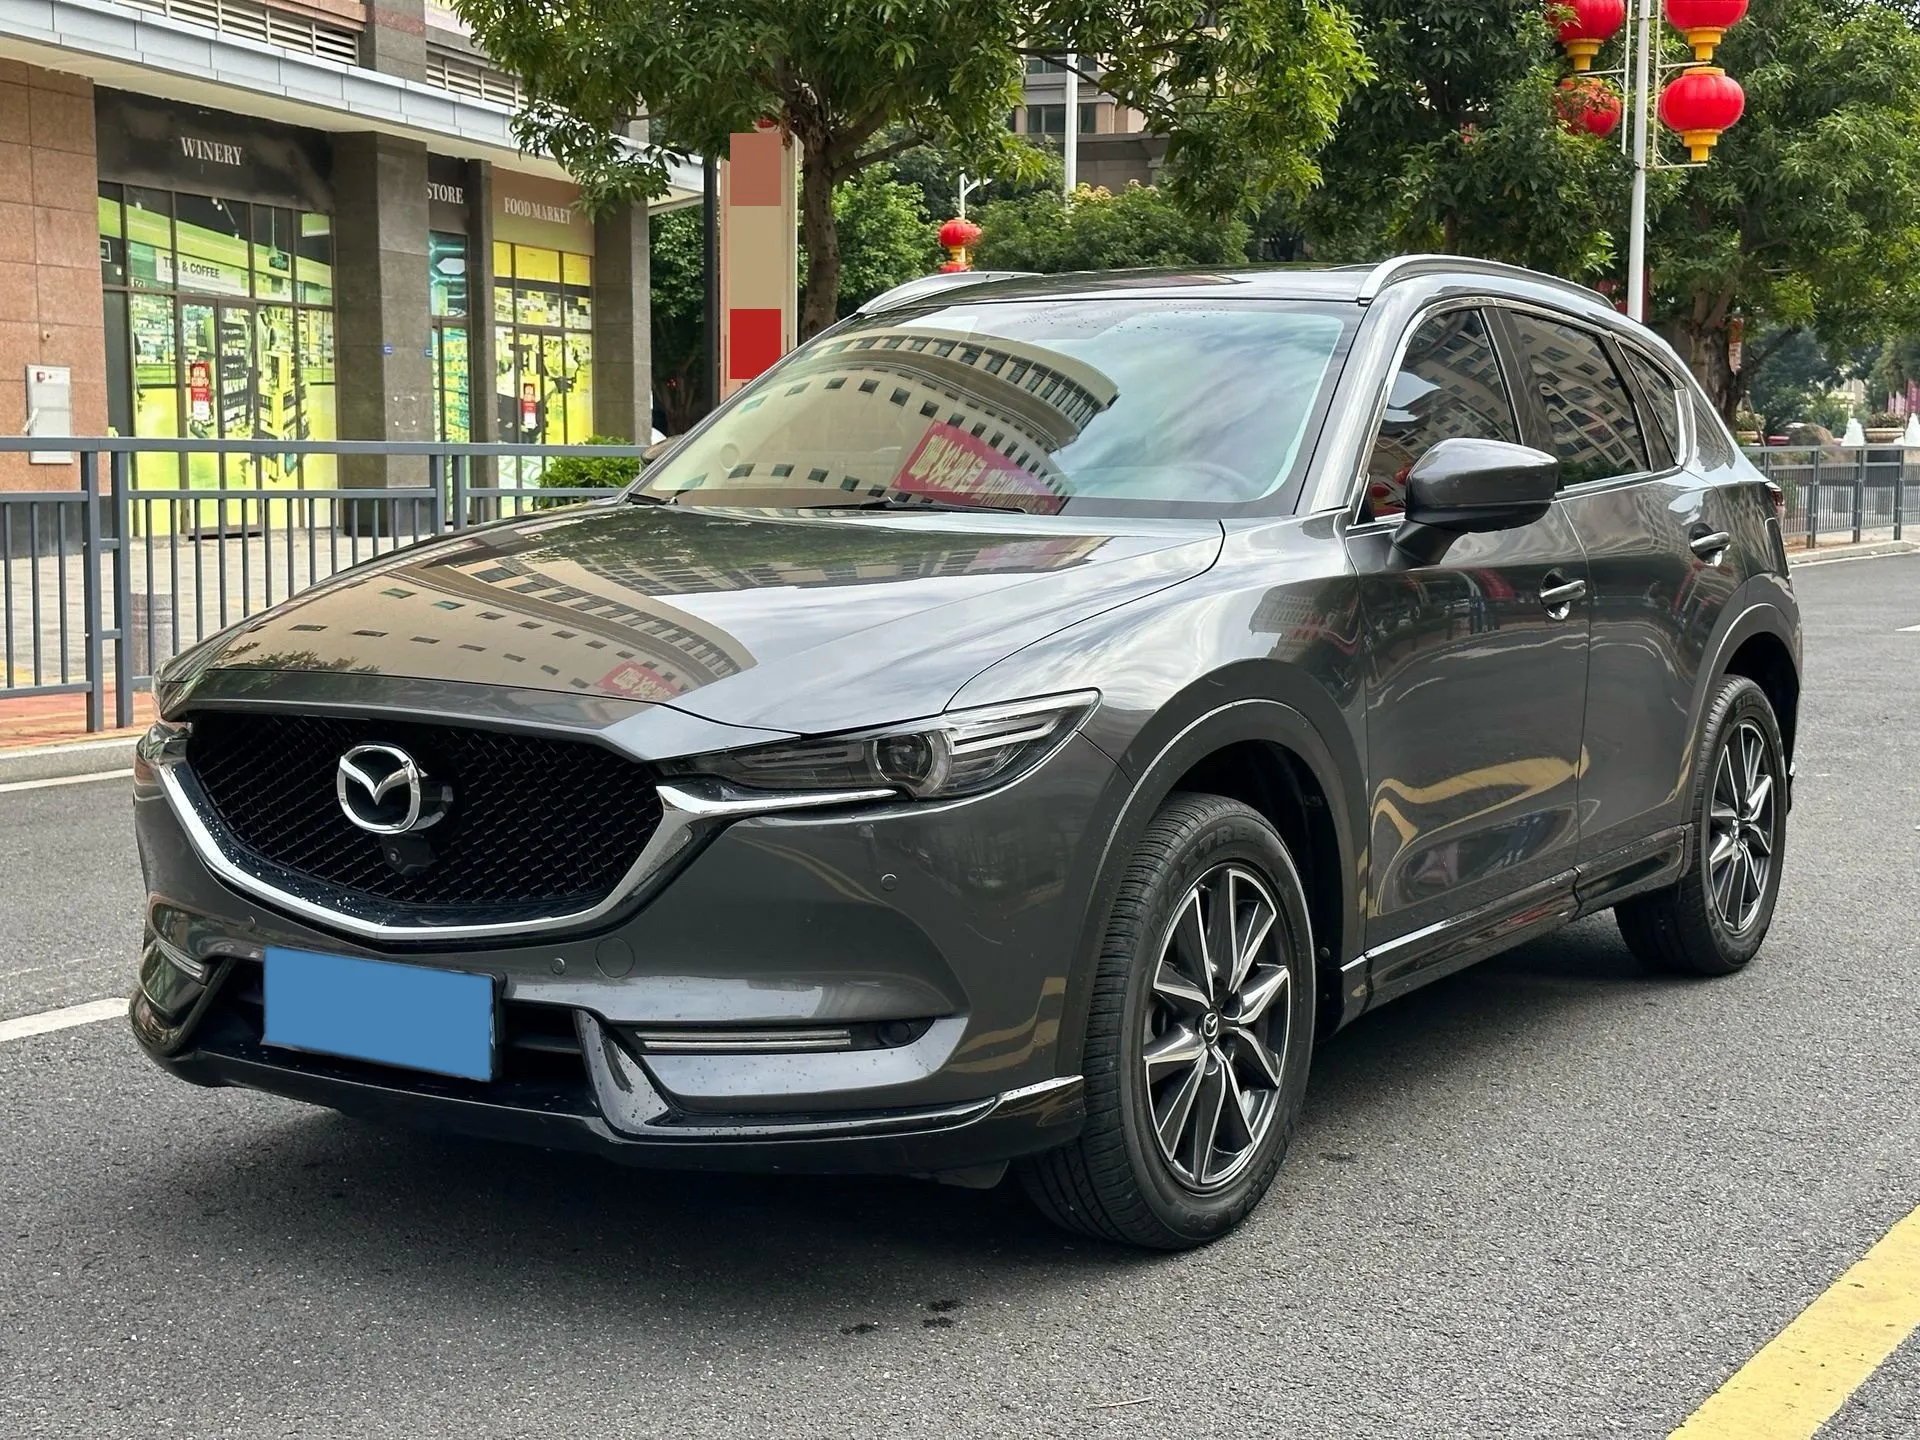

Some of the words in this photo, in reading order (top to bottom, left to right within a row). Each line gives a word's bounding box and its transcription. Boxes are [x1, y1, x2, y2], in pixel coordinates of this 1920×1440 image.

[180, 136, 243, 166] WINERY
[427, 182, 464, 205] STORE
[504, 197, 531, 217] FOOD
[532, 202, 572, 225] MARKET
[190, 263, 220, 279] COFFEE
